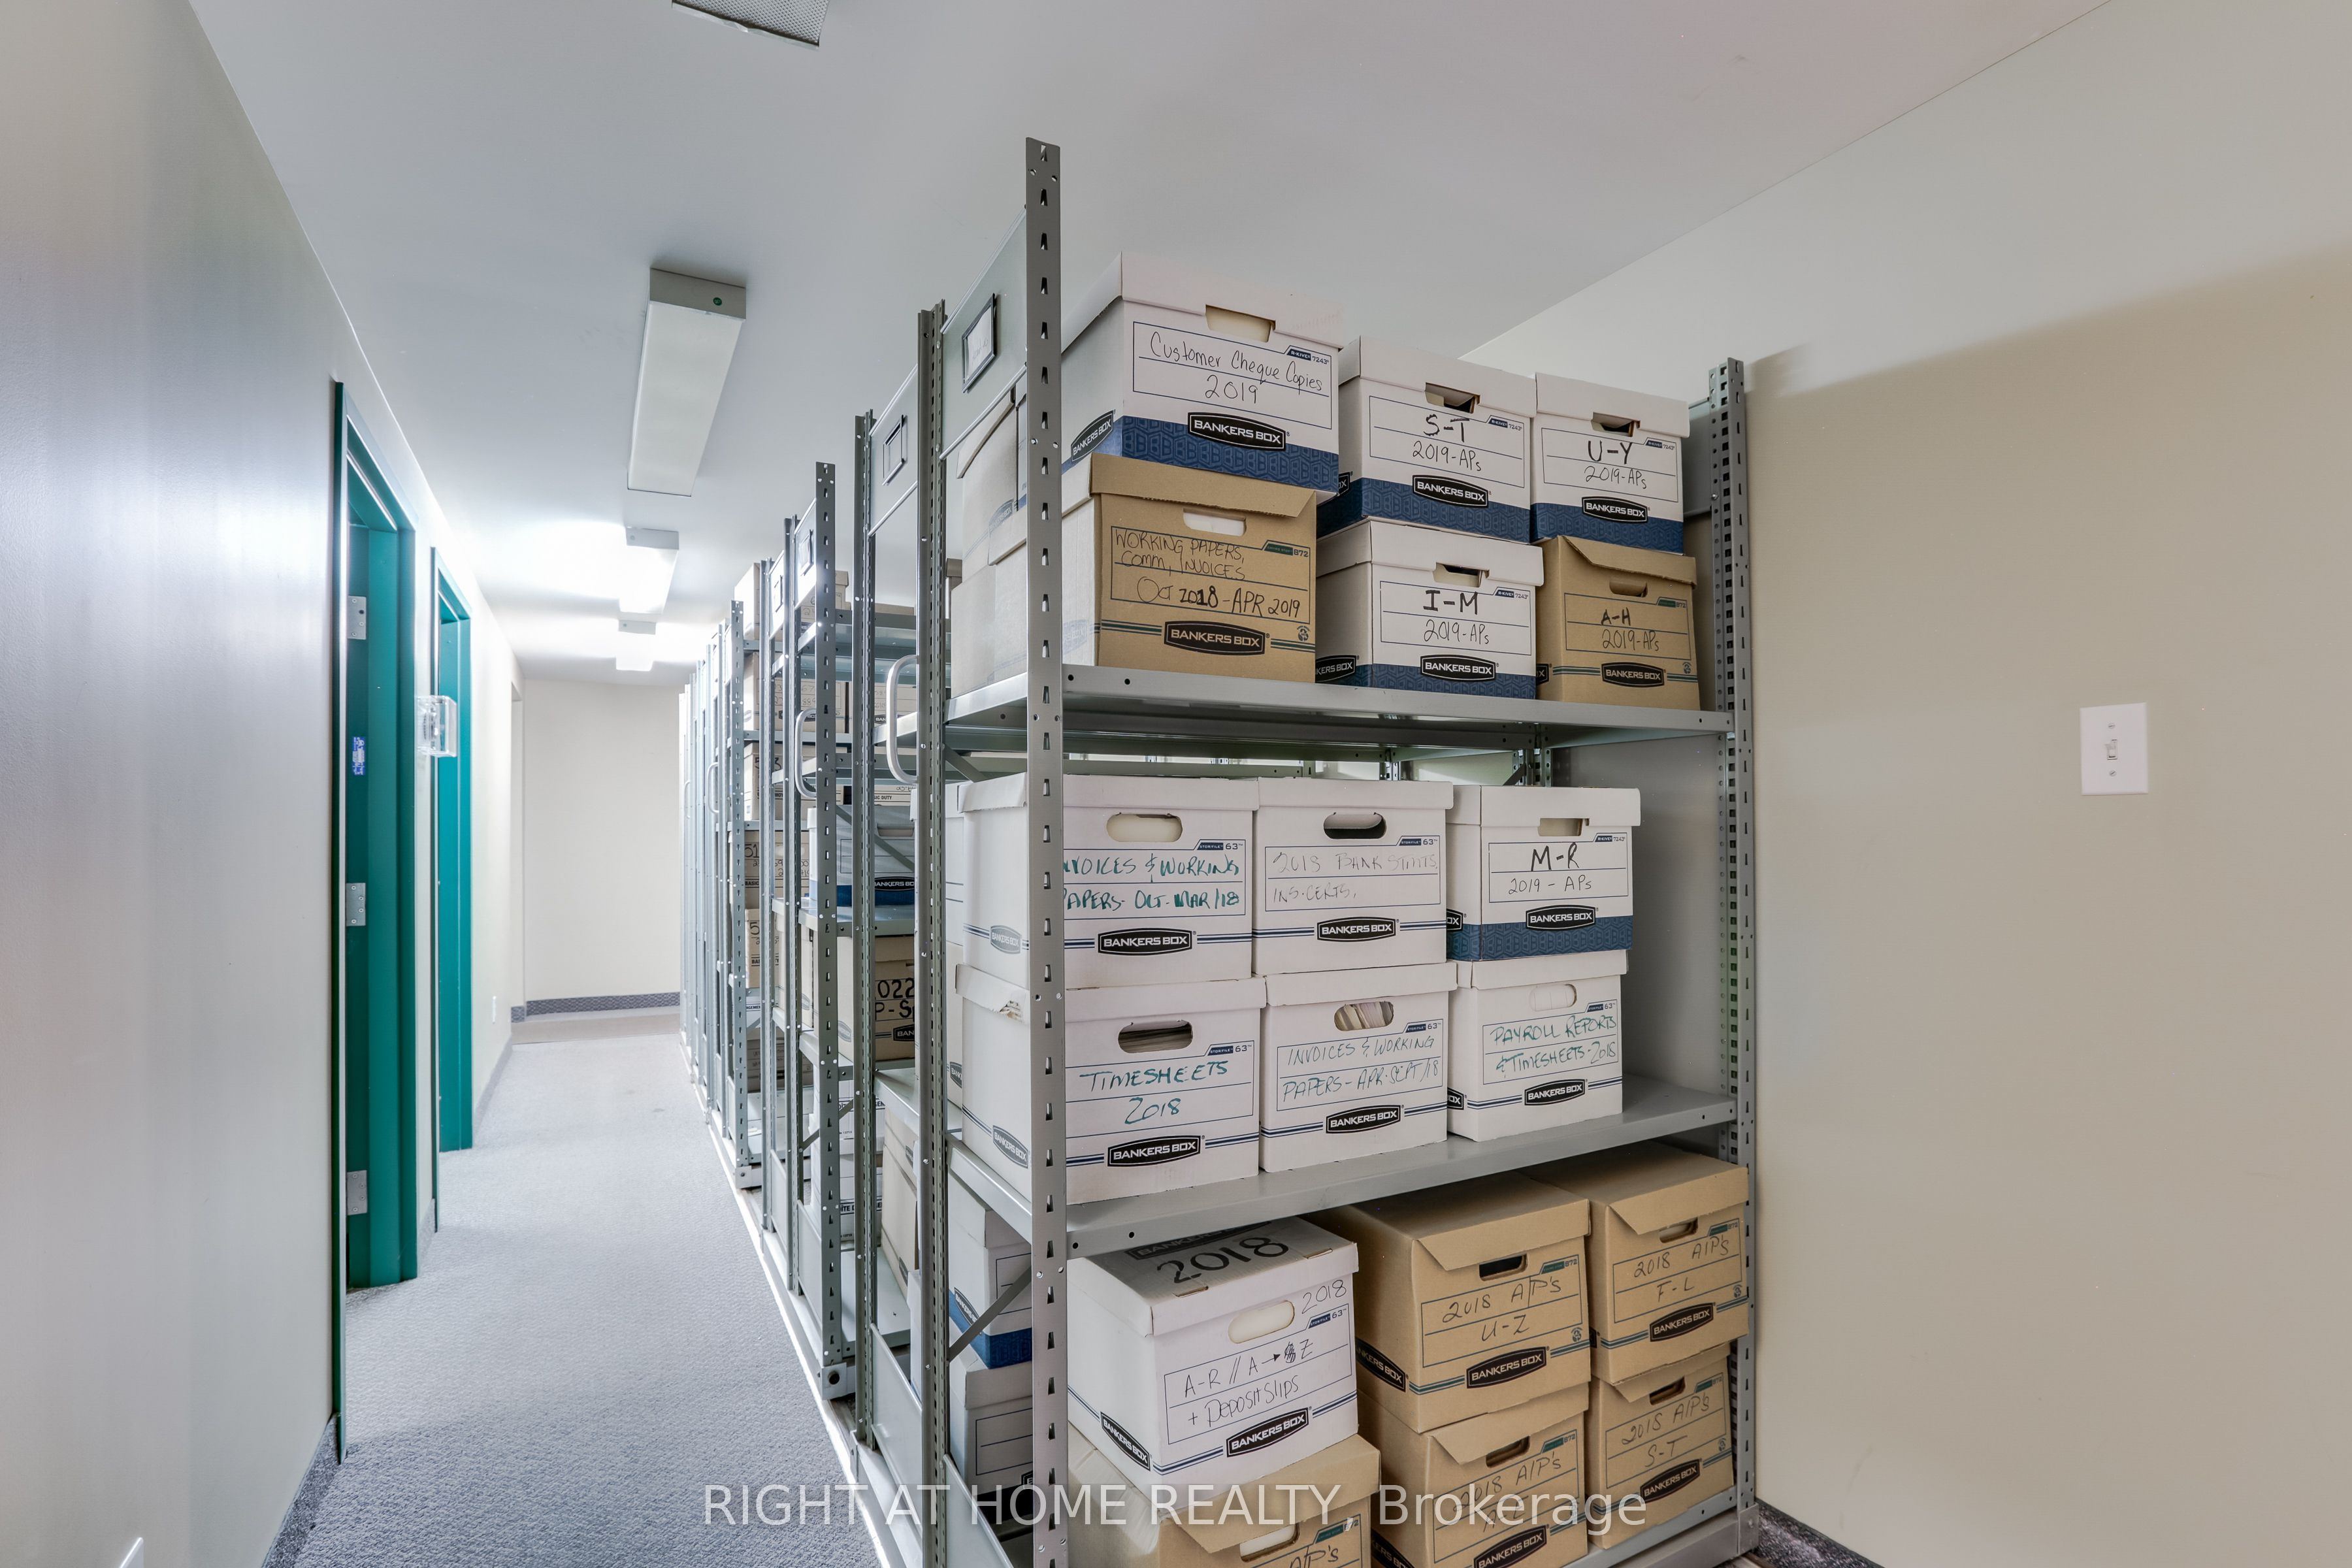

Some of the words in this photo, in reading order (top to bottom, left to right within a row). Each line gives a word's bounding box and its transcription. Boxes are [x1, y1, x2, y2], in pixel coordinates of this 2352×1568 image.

[1151, 332, 1222, 367] Customer
[1231, 350, 1279, 385] Cheque
[1286, 361, 1322, 395] Copies
[1205, 375, 1258, 404] 2019
[1073, 430, 1098, 456] BANKERS
[1098, 419, 1111, 436] BOX
[1194, 419, 1254, 442] BANKERS
[1255, 429, 1281, 445] BOX
[1423, 414, 1470, 442] S-T
[1588, 440, 1633, 465] U-Y
[1417, 481, 1463, 498] BANKERS
[1465, 490, 1484, 502] BOX
[1586, 502, 1626, 515] BANKERS
[1627, 508, 1644, 517] BOX
[1115, 529, 1183, 554] WORKING
[1179, 585, 1220, 608] 2018
[1268, 598, 1300, 618] 2019
[1423, 590, 1478, 615] I-M
[1601, 607, 1631, 625] A-H
[1171, 629, 1232, 645] BANKERS
[1233, 635, 1260, 647] BOX
[1316, 664, 1335, 676] KERS
[1336, 662, 1353, 673] BOX
[1425, 662, 1471, 673] BANKERS
[1472, 665, 1492, 675] BOX
[1605, 669, 1643, 679] BANKERS
[1644, 672, 1661, 681] BOX
[1160, 854, 1239, 876] WORKING
[1335, 853, 1382, 870] BANK
[1322, 926, 1371, 934] BANKERS
[1371, 923, 1392, 932] BOX
[1446, 916, 1460, 926] OX
[1530, 913, 1573, 923] BANKERS
[1573, 912, 1592, 921] BOX
[1103, 936, 1161, 947] BANKERS
[1162, 934, 1188, 945] BOX
[877, 977, 915, 999] 022
[1490, 1025, 1561, 1045] PAYROLL
[1565, 1015, 1617, 1038] REPORTS
[1288, 1043, 1356, 1066] INVOICES
[1374, 1036, 1434, 1056] WORKING
[1080, 1060, 1228, 1092] TIMESHEETS
[1448, 1095, 1461, 1105] OX
[1528, 1088, 1565, 1101] BANKERS
[1566, 1084, 1582, 1093] BOX
[1125, 1097, 1181, 1124] 2018
[1330, 1113, 1377, 1128] BANKERS
[1377, 1109, 1397, 1120] BOX
[994, 1132, 1016, 1154] BANKERS
[1015, 1148, 1027, 1162] BOX
[1113, 1145, 1171, 1160] BANKERS
[1171, 1141, 1196, 1152] BOX
[1157, 1237, 1289, 1283] 2018
[1634, 1251, 1671, 1277] 2018
[1301, 1280, 1347, 1314] 2018
[1654, 1316, 1693, 1335] BANKERS
[1693, 1309, 1710, 1322] BOX
[1384, 1365, 1402, 1384] BOX
[1471, 1360, 1520, 1380] BANKERS
[1520, 1354, 1543, 1367] BOX
[1103, 1419, 1132, 1452] BANKERS
[1132, 1445, 1148, 1464] BOX
[1232, 1423, 1282, 1450] BANKERS
[1283, 1413, 1305, 1429] BOX
[1644, 1473, 1681, 1497] BANKERS
[1680, 1465, 1697, 1481] BOX
[1478, 1542, 1523, 1568] BANKERS
[1523, 1533, 1543, 1548] BOX
